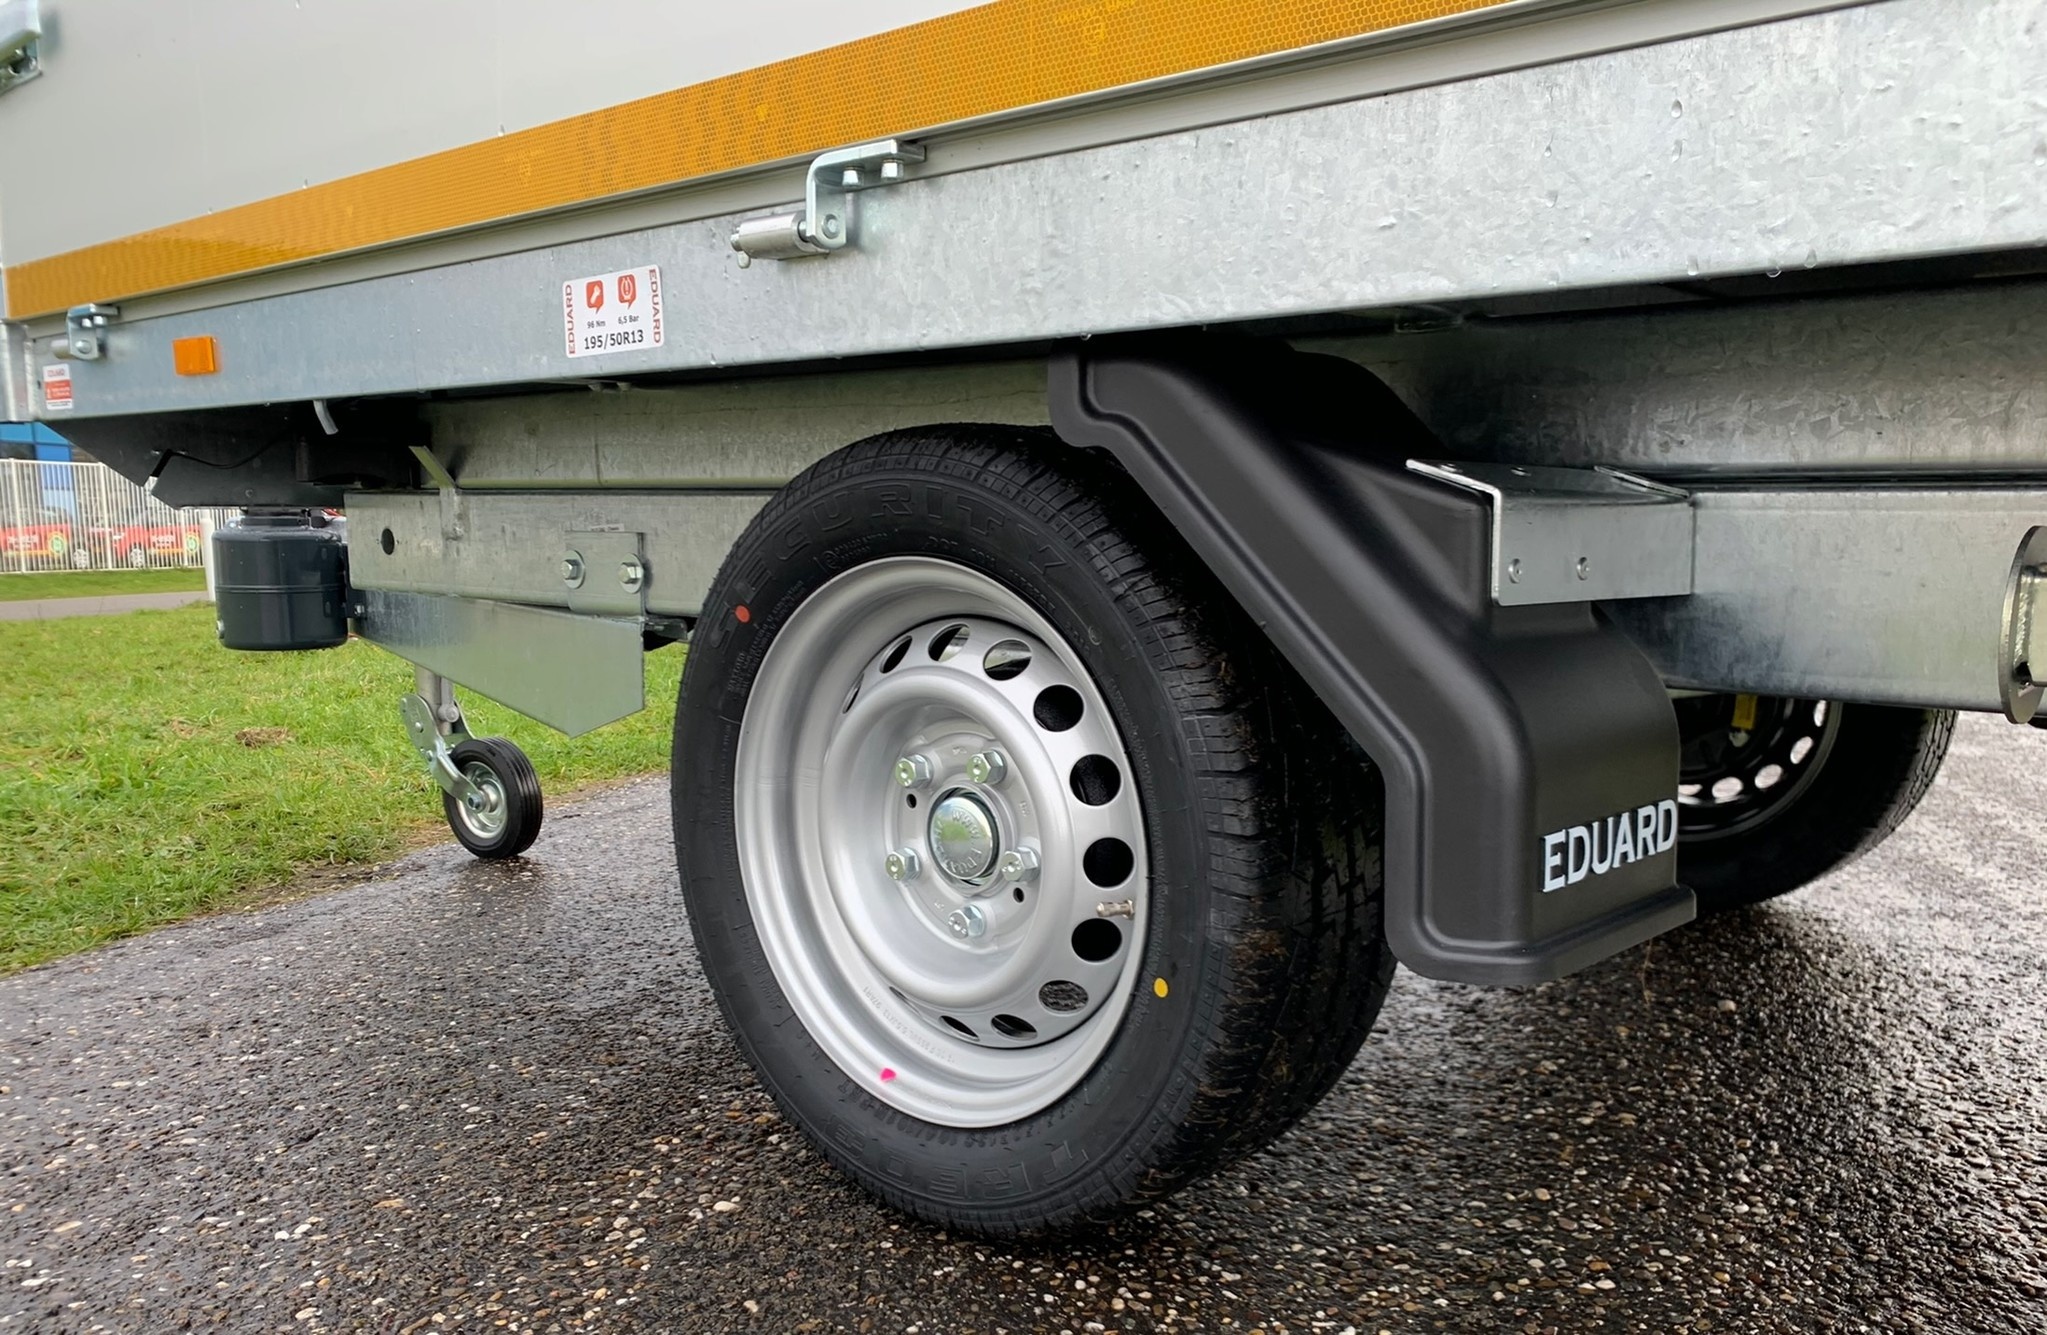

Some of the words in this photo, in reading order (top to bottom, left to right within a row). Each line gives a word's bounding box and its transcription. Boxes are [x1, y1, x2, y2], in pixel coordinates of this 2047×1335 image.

[565, 284, 576, 354] EDUARD
[584, 329, 644, 350] 195/50R13
[596, 320, 606, 328] Nm
[629, 314, 639, 323] Bar
[649, 268, 661, 344] EDUARD
[710, 482, 1068, 648] SECURITY
[1542, 799, 1678, 893] EDUARD
